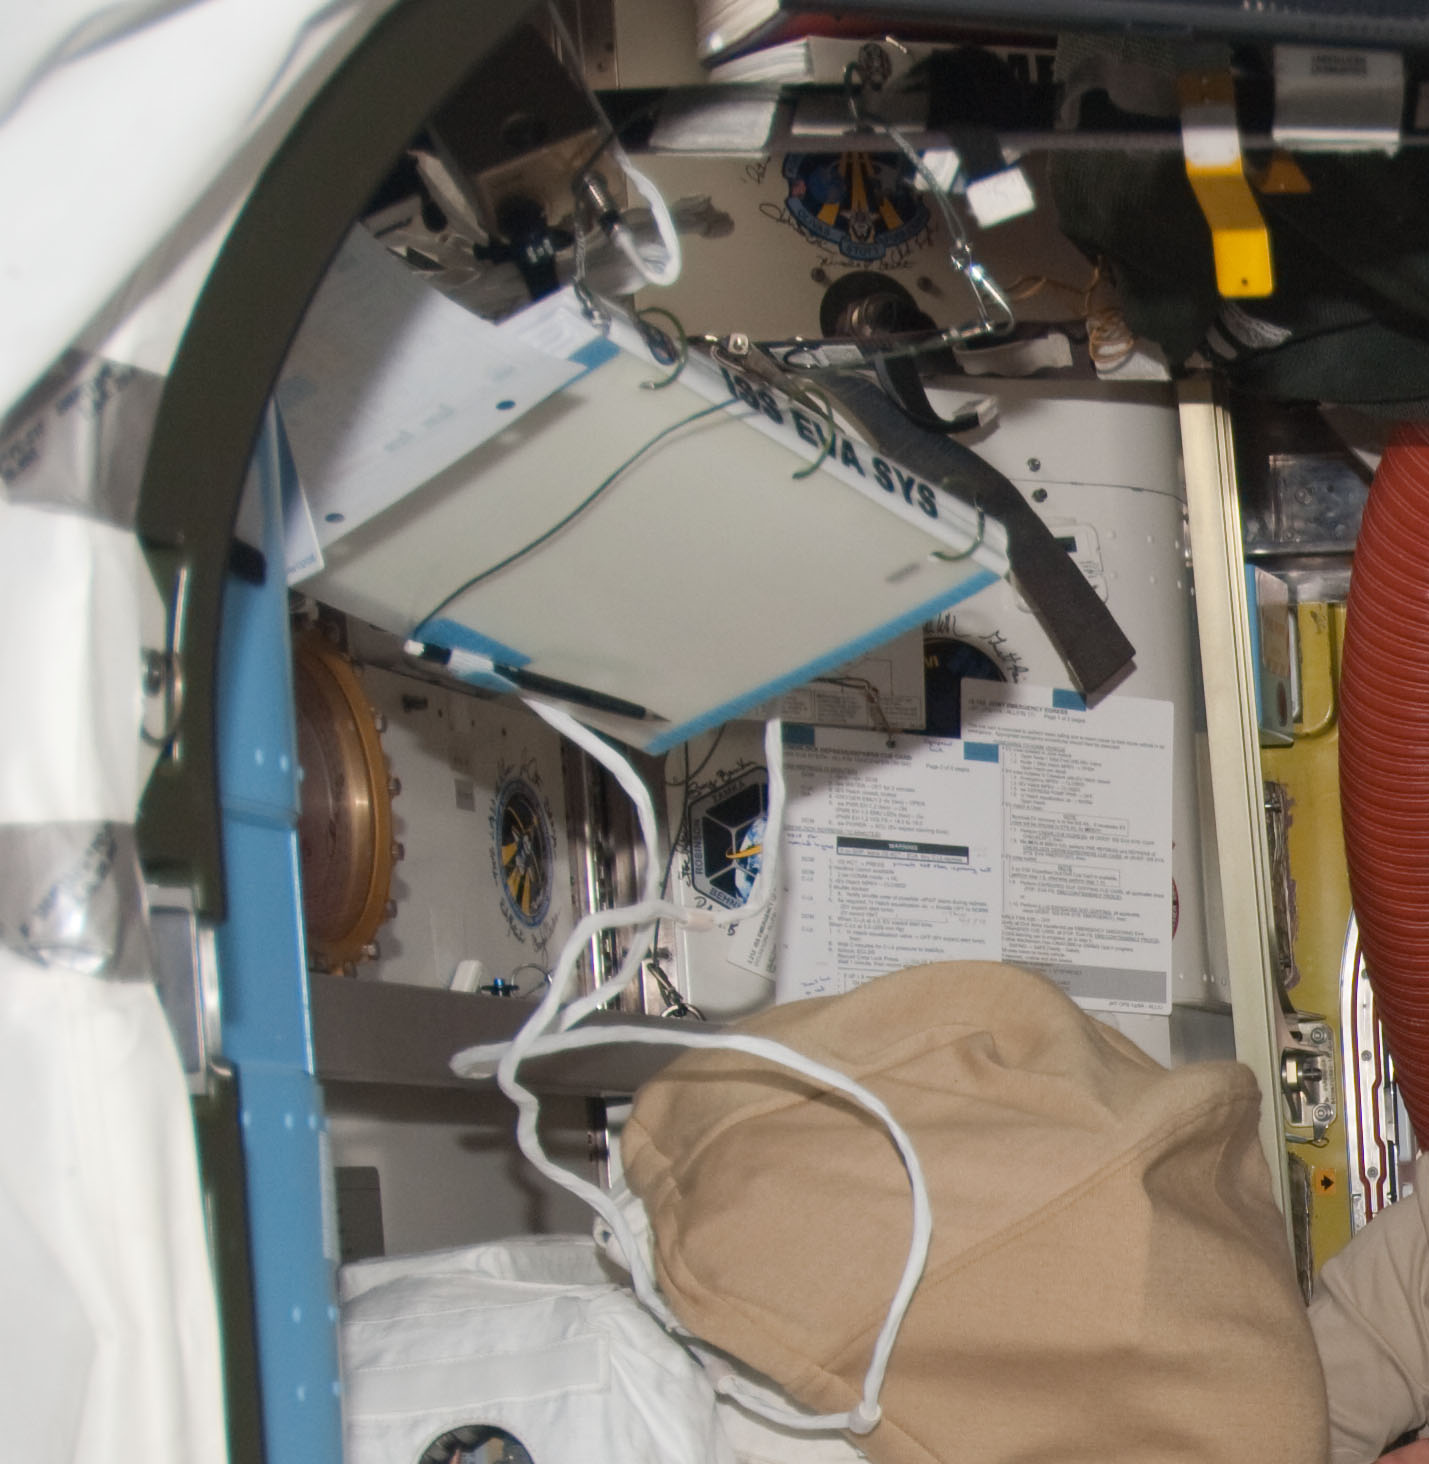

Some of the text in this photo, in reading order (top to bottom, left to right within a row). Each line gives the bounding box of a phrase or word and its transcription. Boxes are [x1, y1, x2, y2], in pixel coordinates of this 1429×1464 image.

[719, 365, 939, 519] ISS EVA SYS
[692, 818, 704, 875] ROBINSON
